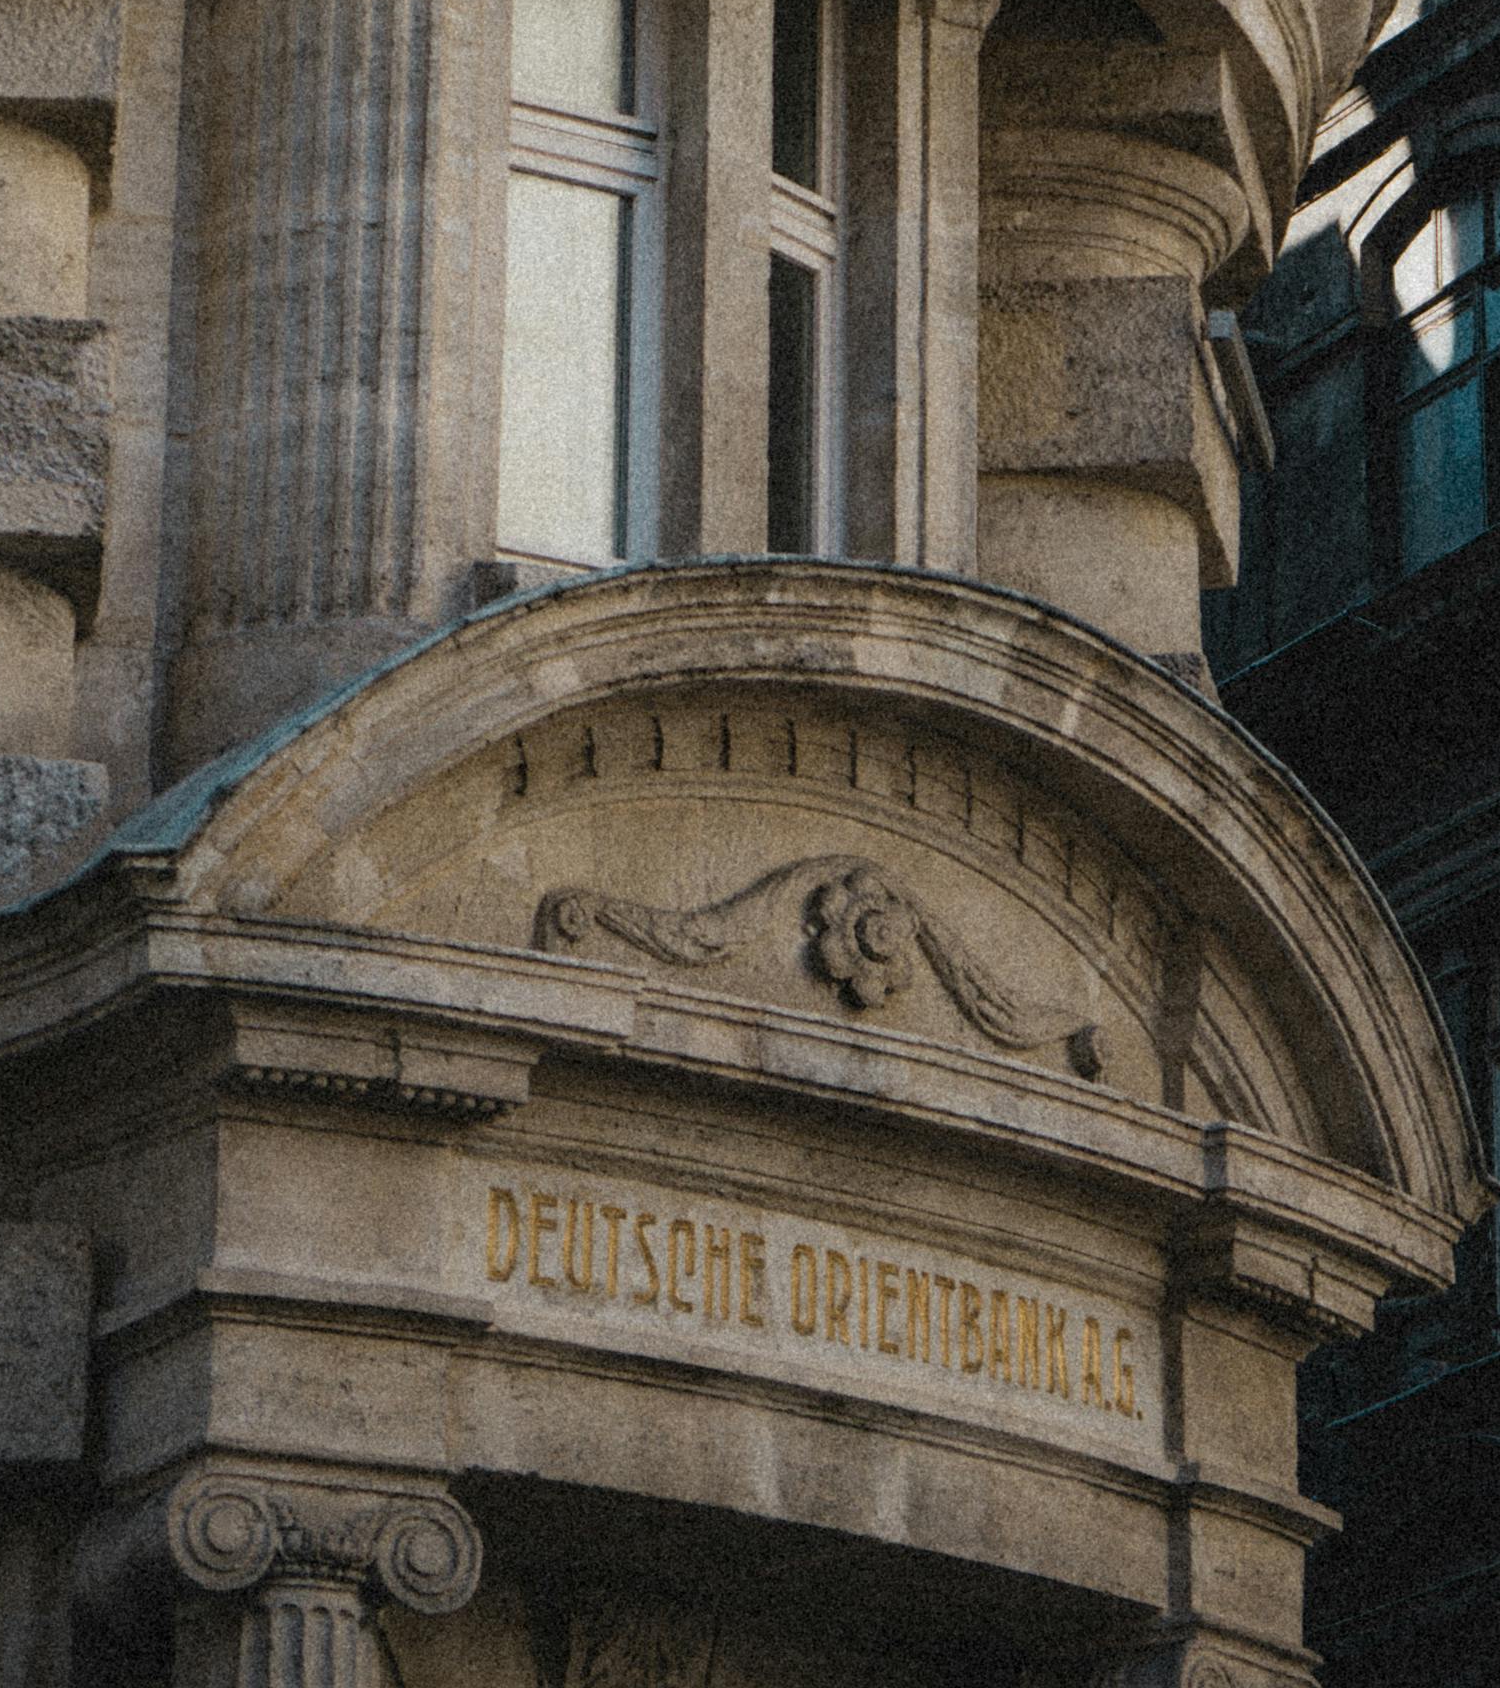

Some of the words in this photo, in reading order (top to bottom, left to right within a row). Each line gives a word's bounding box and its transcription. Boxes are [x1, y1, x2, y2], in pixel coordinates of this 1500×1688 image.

[486, 1186, 767, 1328] DEUTSCHE
[790, 1243, 1069, 1400] ORIENTBANK
[1081, 1315, 1143, 1421] A.G.
